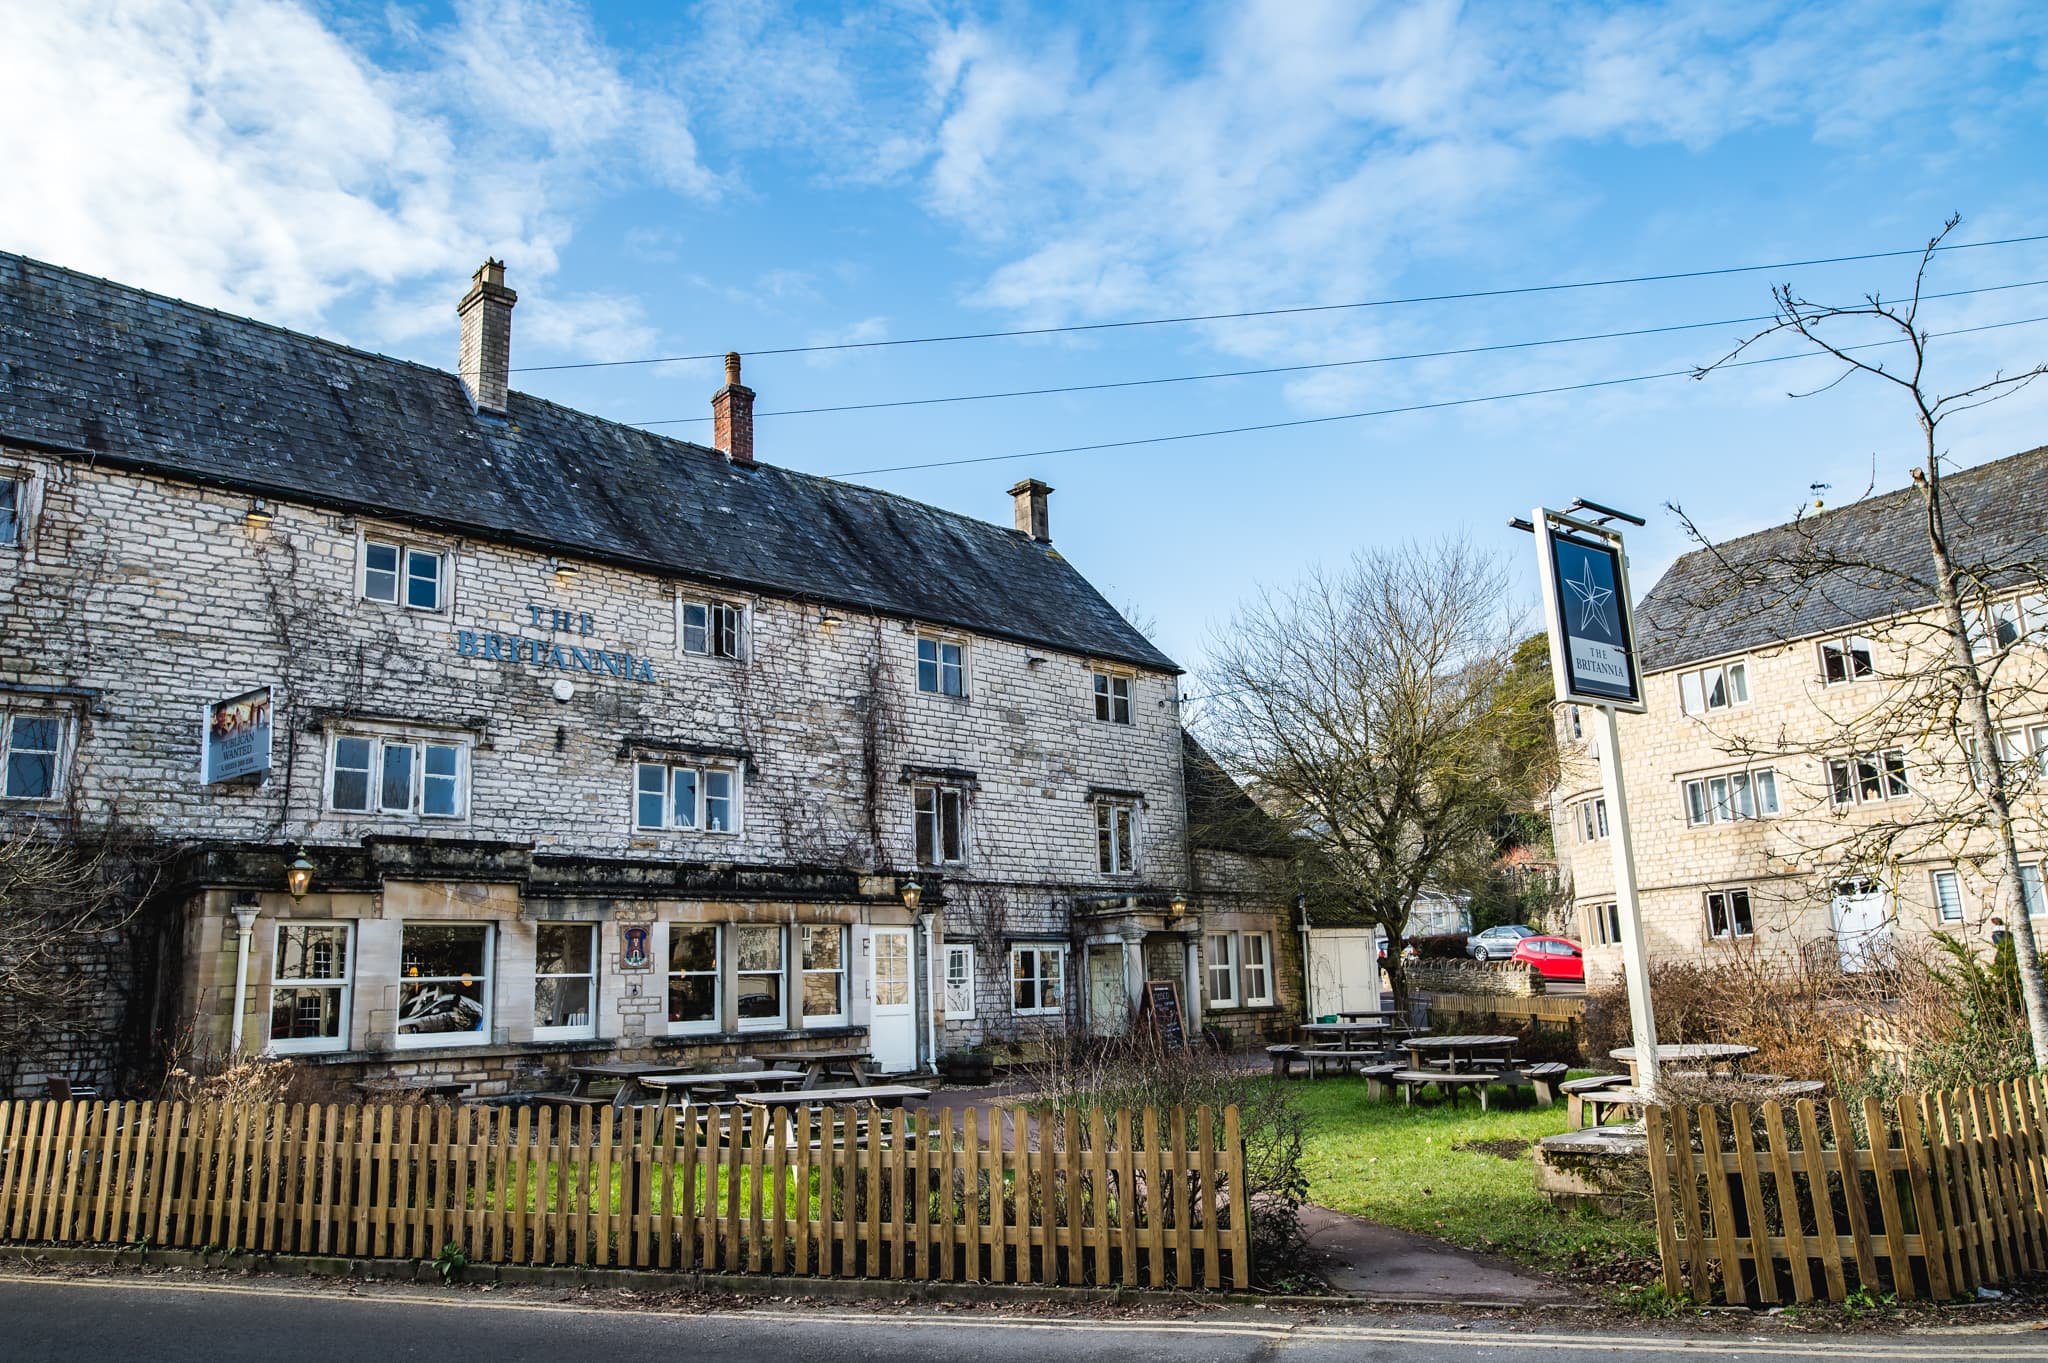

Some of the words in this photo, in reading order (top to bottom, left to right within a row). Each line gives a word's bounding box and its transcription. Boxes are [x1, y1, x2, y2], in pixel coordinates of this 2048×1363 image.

[526, 604, 595, 635] THE
[457, 629, 657, 683] BRITANNIA
[1590, 648, 1608, 659] THE
[1576, 658, 1624, 677] BRITANNIA
[221, 731, 255, 750] PUBLICAN
[223, 744, 253, 761] WANTED
